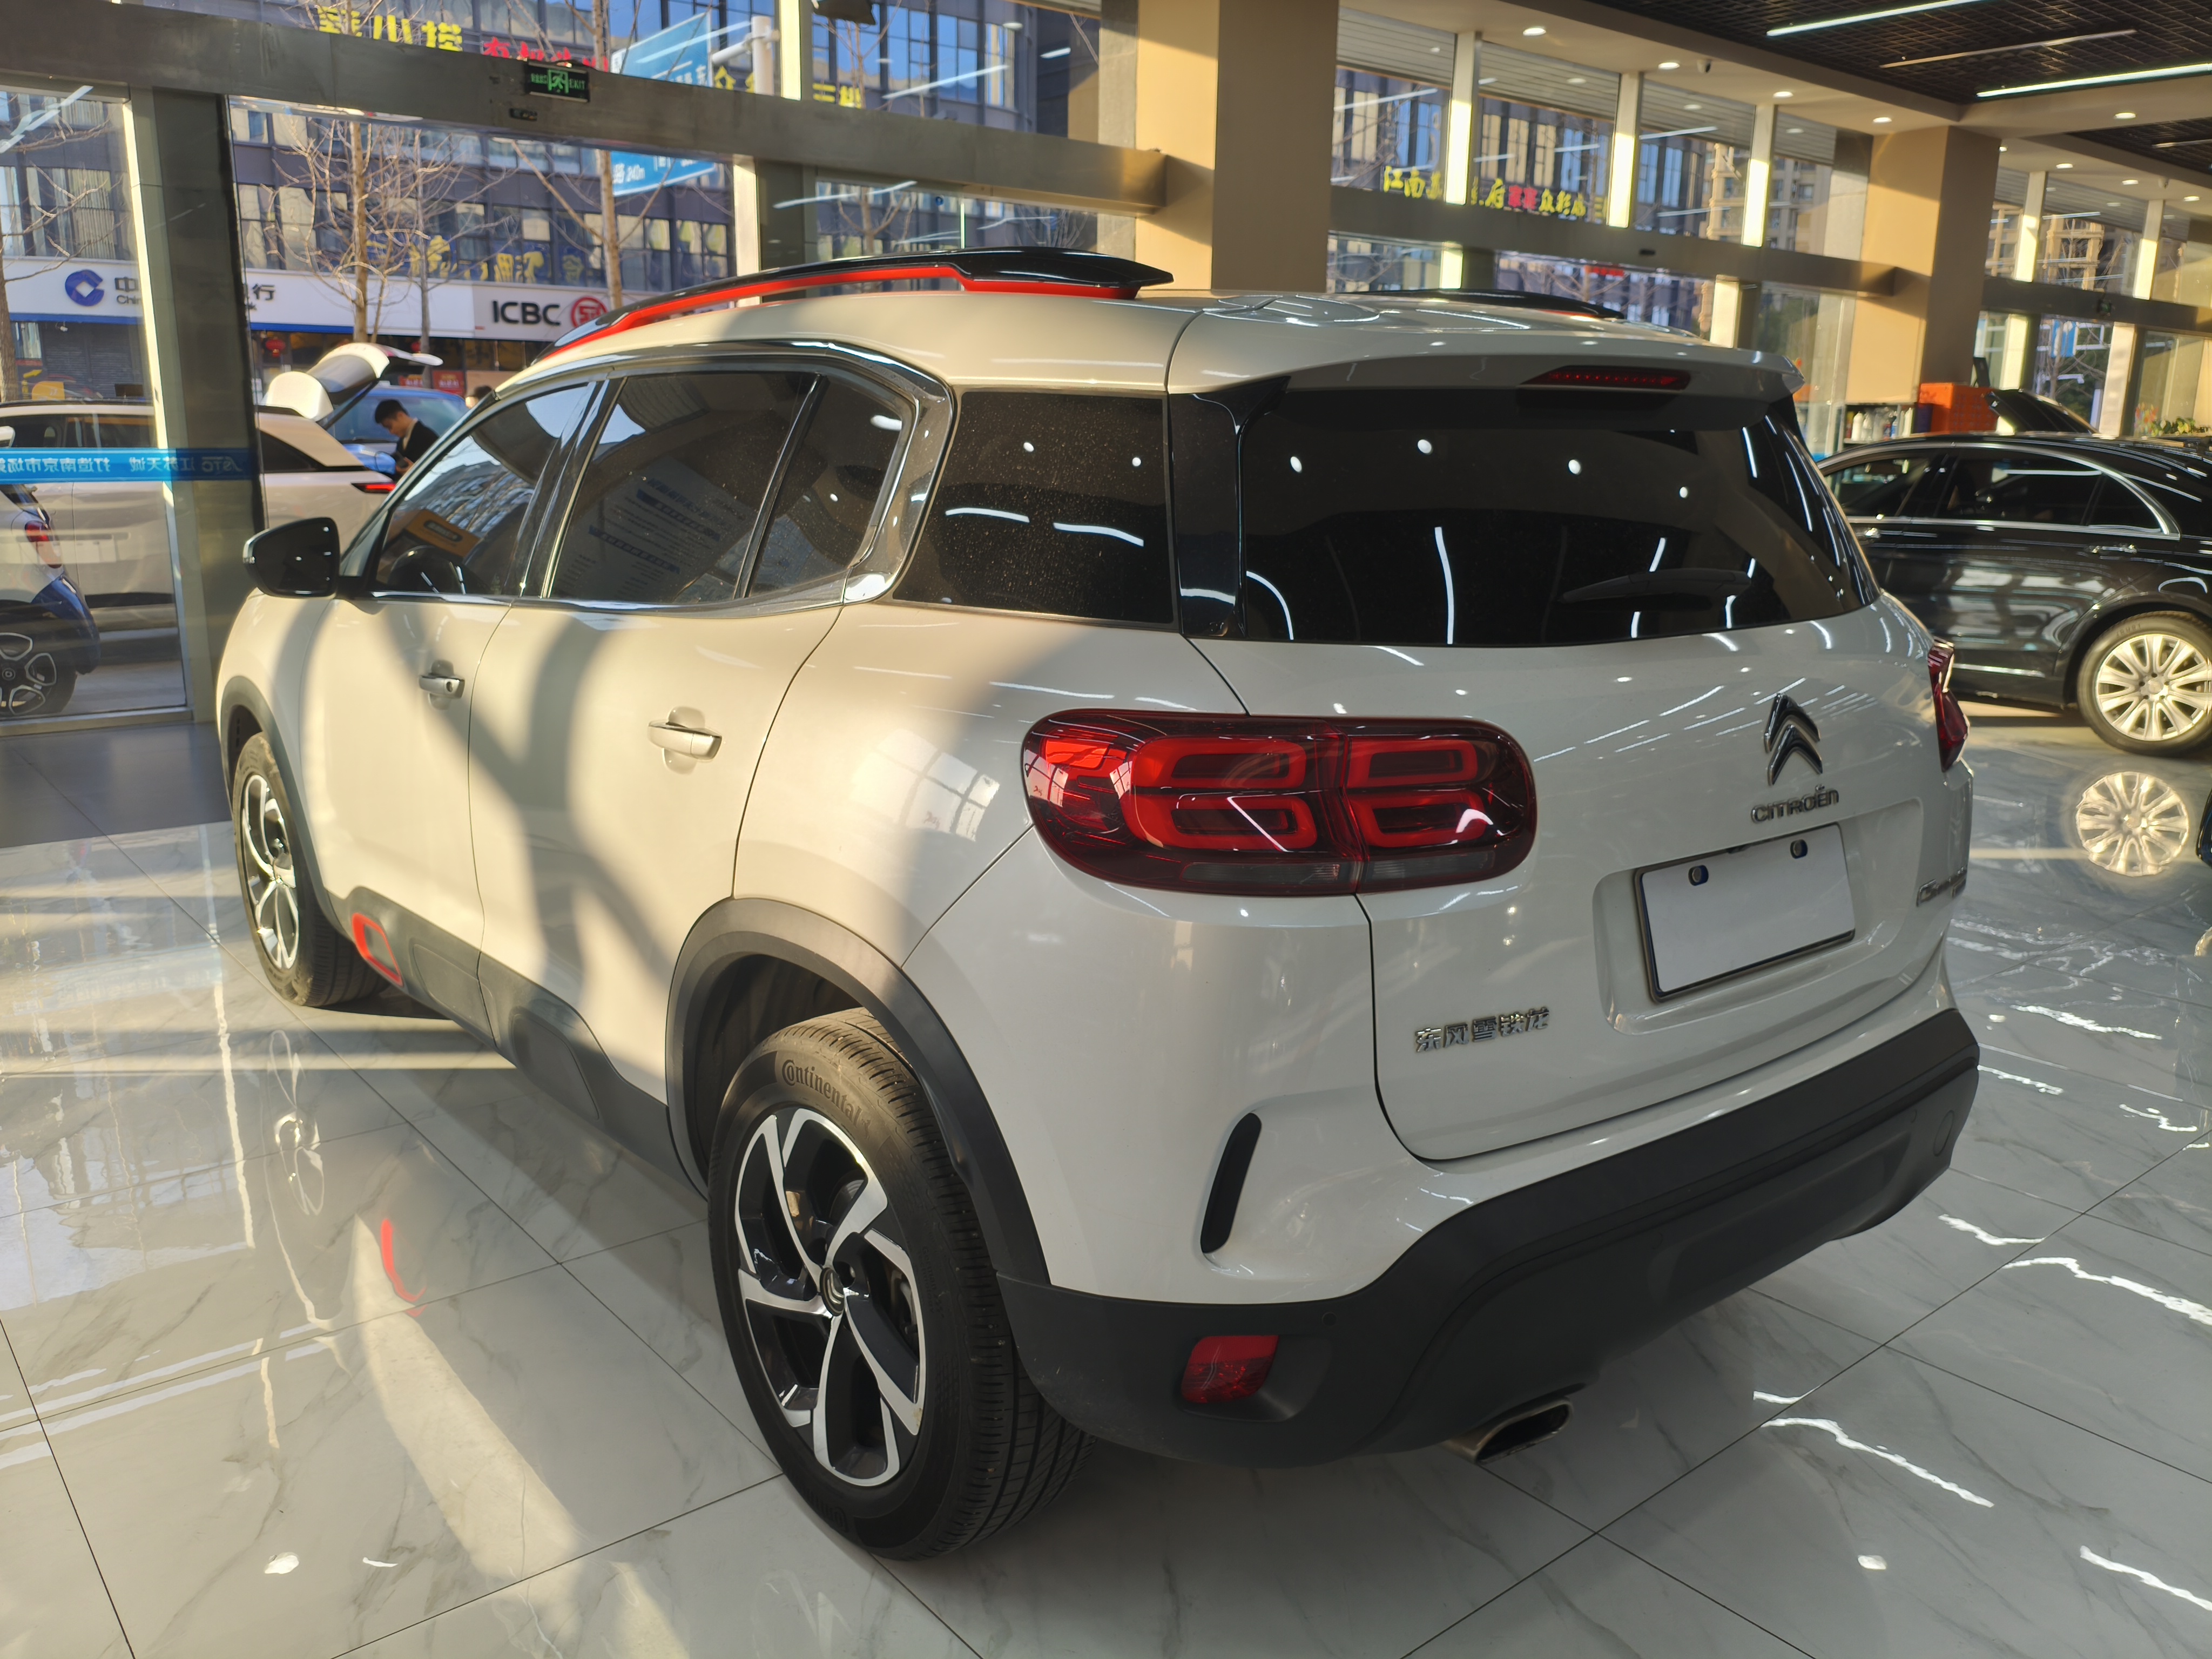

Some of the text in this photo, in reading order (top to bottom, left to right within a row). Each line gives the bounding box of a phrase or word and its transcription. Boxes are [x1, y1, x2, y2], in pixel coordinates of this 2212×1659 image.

[252, 284, 275, 300] 行
[492, 300, 561, 326] ICBC
[1414, 1006, 1549, 1053] 东风雪铁龙
[782, 1059, 862, 1127] Continental
